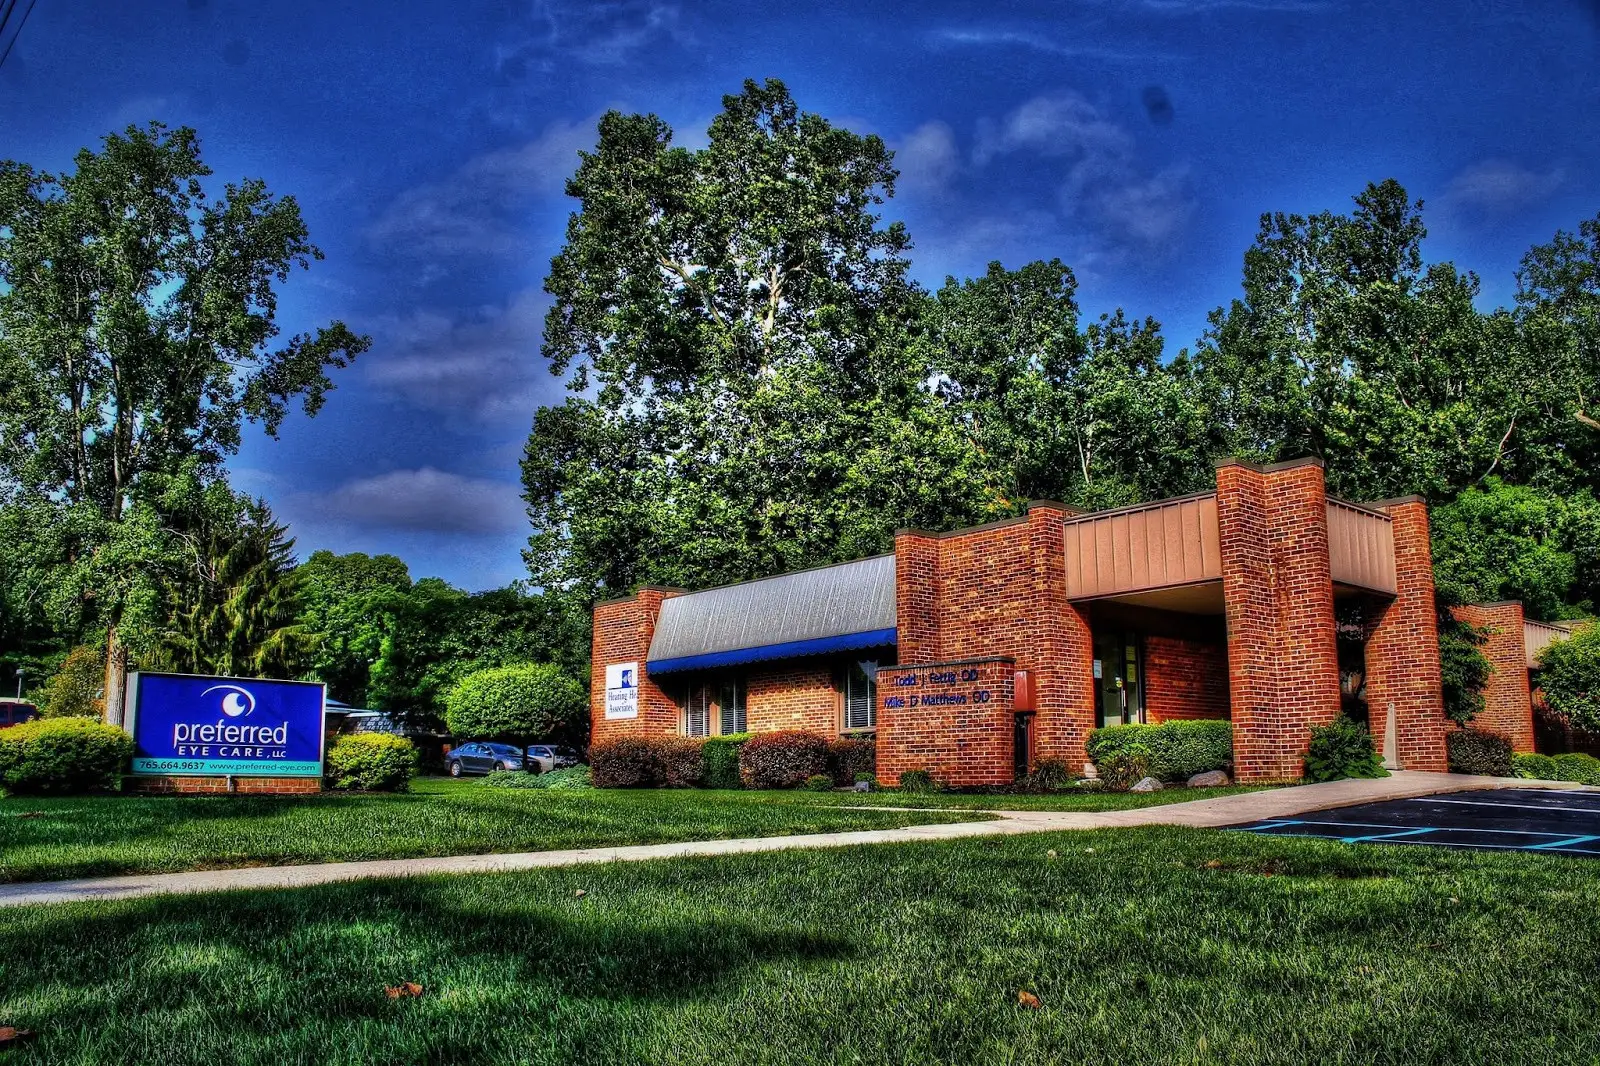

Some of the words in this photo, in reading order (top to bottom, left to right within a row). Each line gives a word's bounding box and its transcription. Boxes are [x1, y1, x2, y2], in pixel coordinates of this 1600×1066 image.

[894, 674, 916, 686] Todd
[961, 670, 978, 681] OD
[885, 696, 904, 708] Mike
[910, 696, 918, 707] D
[921, 693, 966, 706] Matthews
[973, 691, 990, 703] OD
[173, 719, 288, 749] preferred
[178, 746, 209, 756] EYE
[139, 760, 205, 770] 765.664.9637
[209, 763, 315, 772] www.preferred-eye.com
